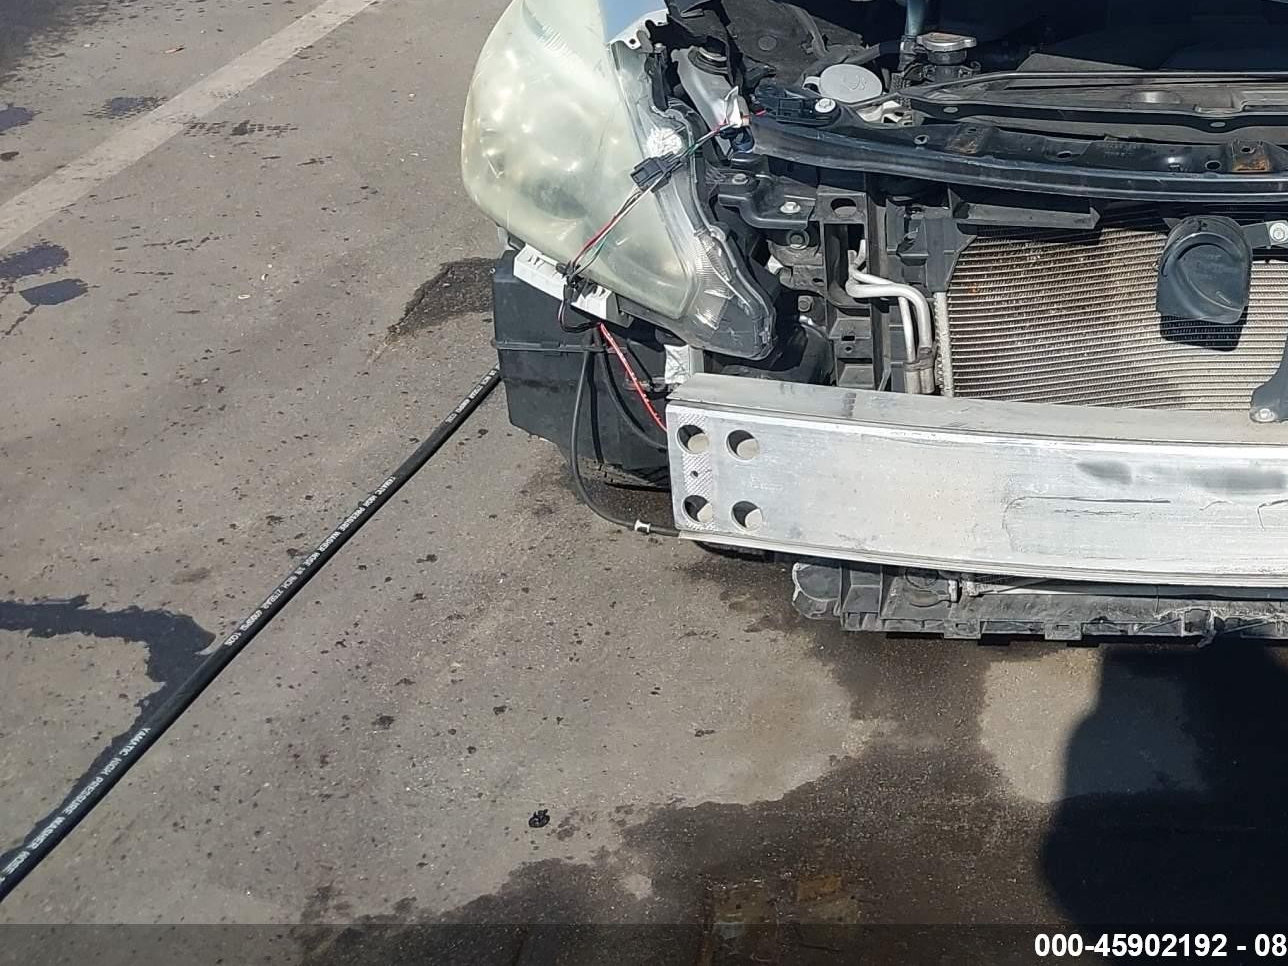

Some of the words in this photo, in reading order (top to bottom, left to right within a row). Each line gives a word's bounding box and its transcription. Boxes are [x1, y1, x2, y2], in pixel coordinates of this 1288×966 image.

[337, 506, 366, 532] PRESSURE
[316, 531, 342, 552] WASHER
[119, 727, 151, 756] YAMATIC
[101, 757, 122, 776] HIGH
[62, 776, 104, 815] PRESSURE
[25, 816, 66, 850] WASHER
[1, 850, 31, 875] HOSE
